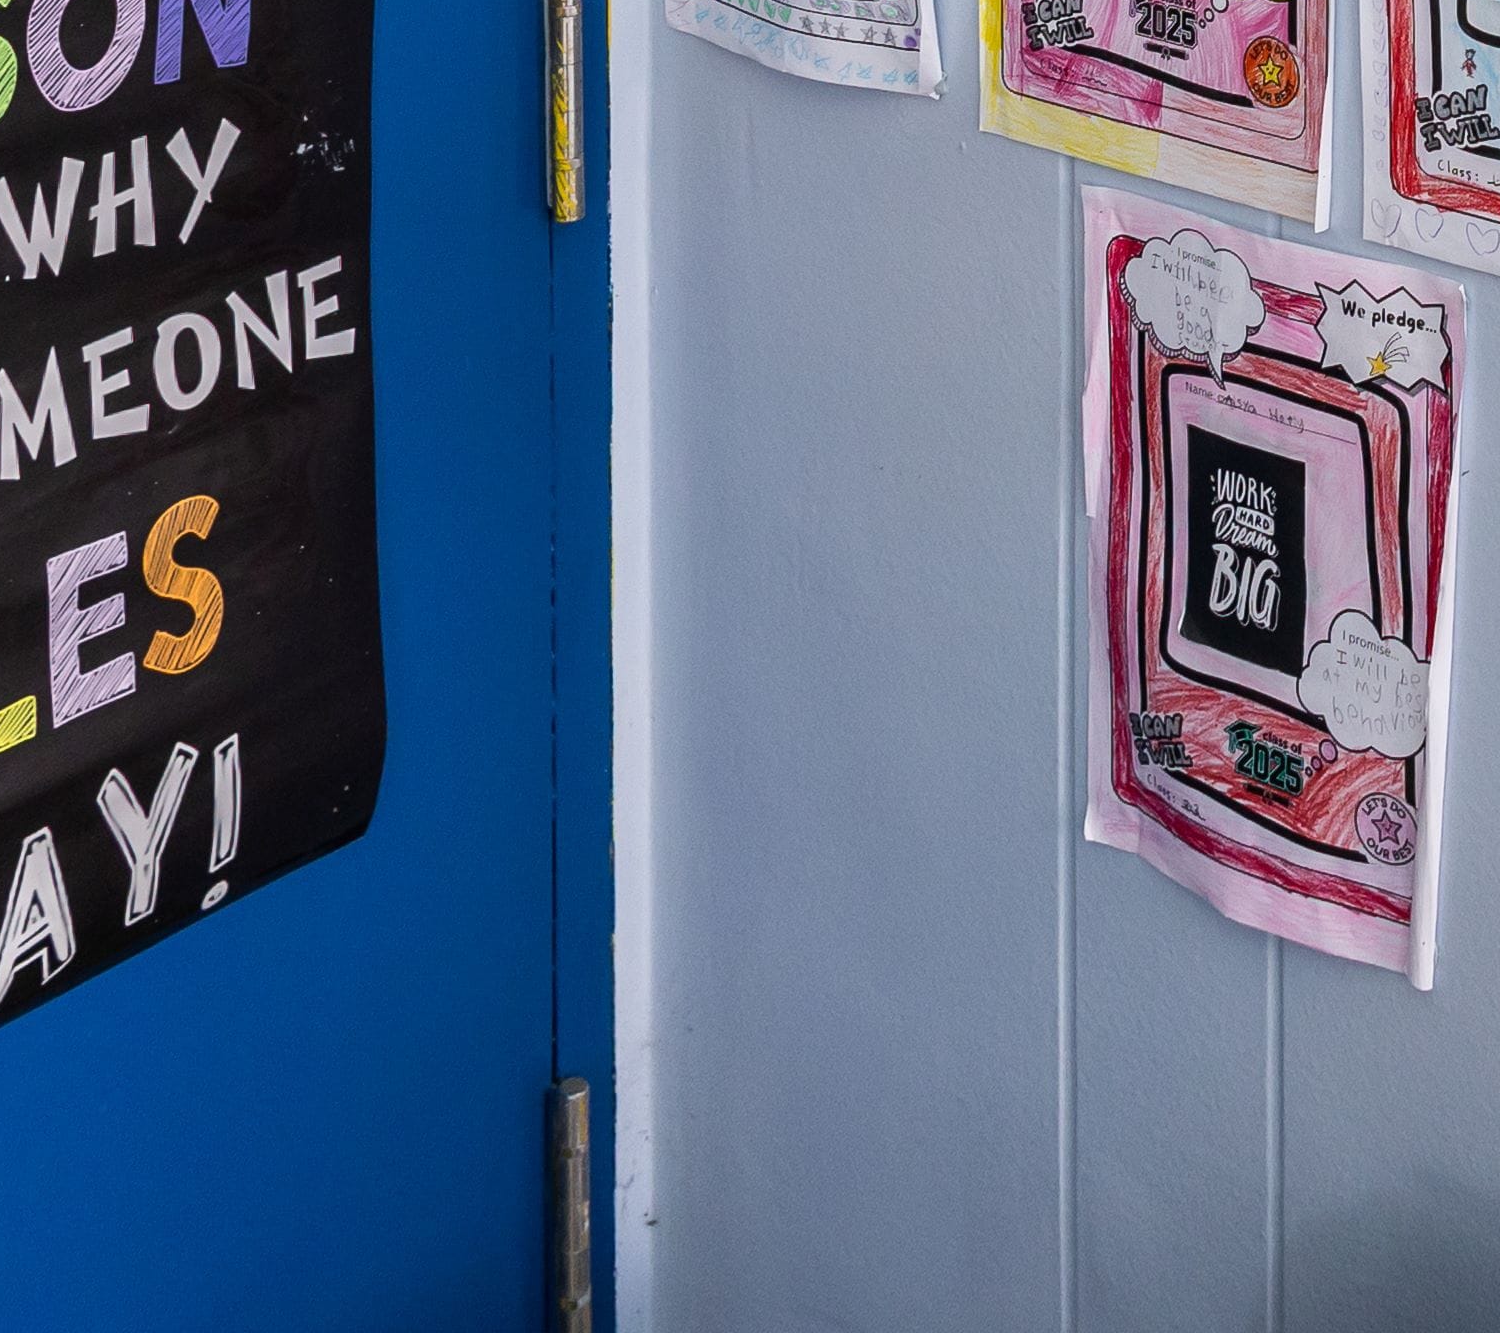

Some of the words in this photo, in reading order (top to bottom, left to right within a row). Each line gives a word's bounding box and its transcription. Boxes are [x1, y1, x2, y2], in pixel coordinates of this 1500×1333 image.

[1341, 298, 1366, 319] We
[1371, 308, 1437, 334] pledge...
[1217, 468, 1274, 513] WORK
[1212, 502, 1279, 557] Dream
[1237, 510, 1271, 531] HARD
[1208, 542, 1281, 632] BIG
[1235, 738, 1306, 796] 2025
